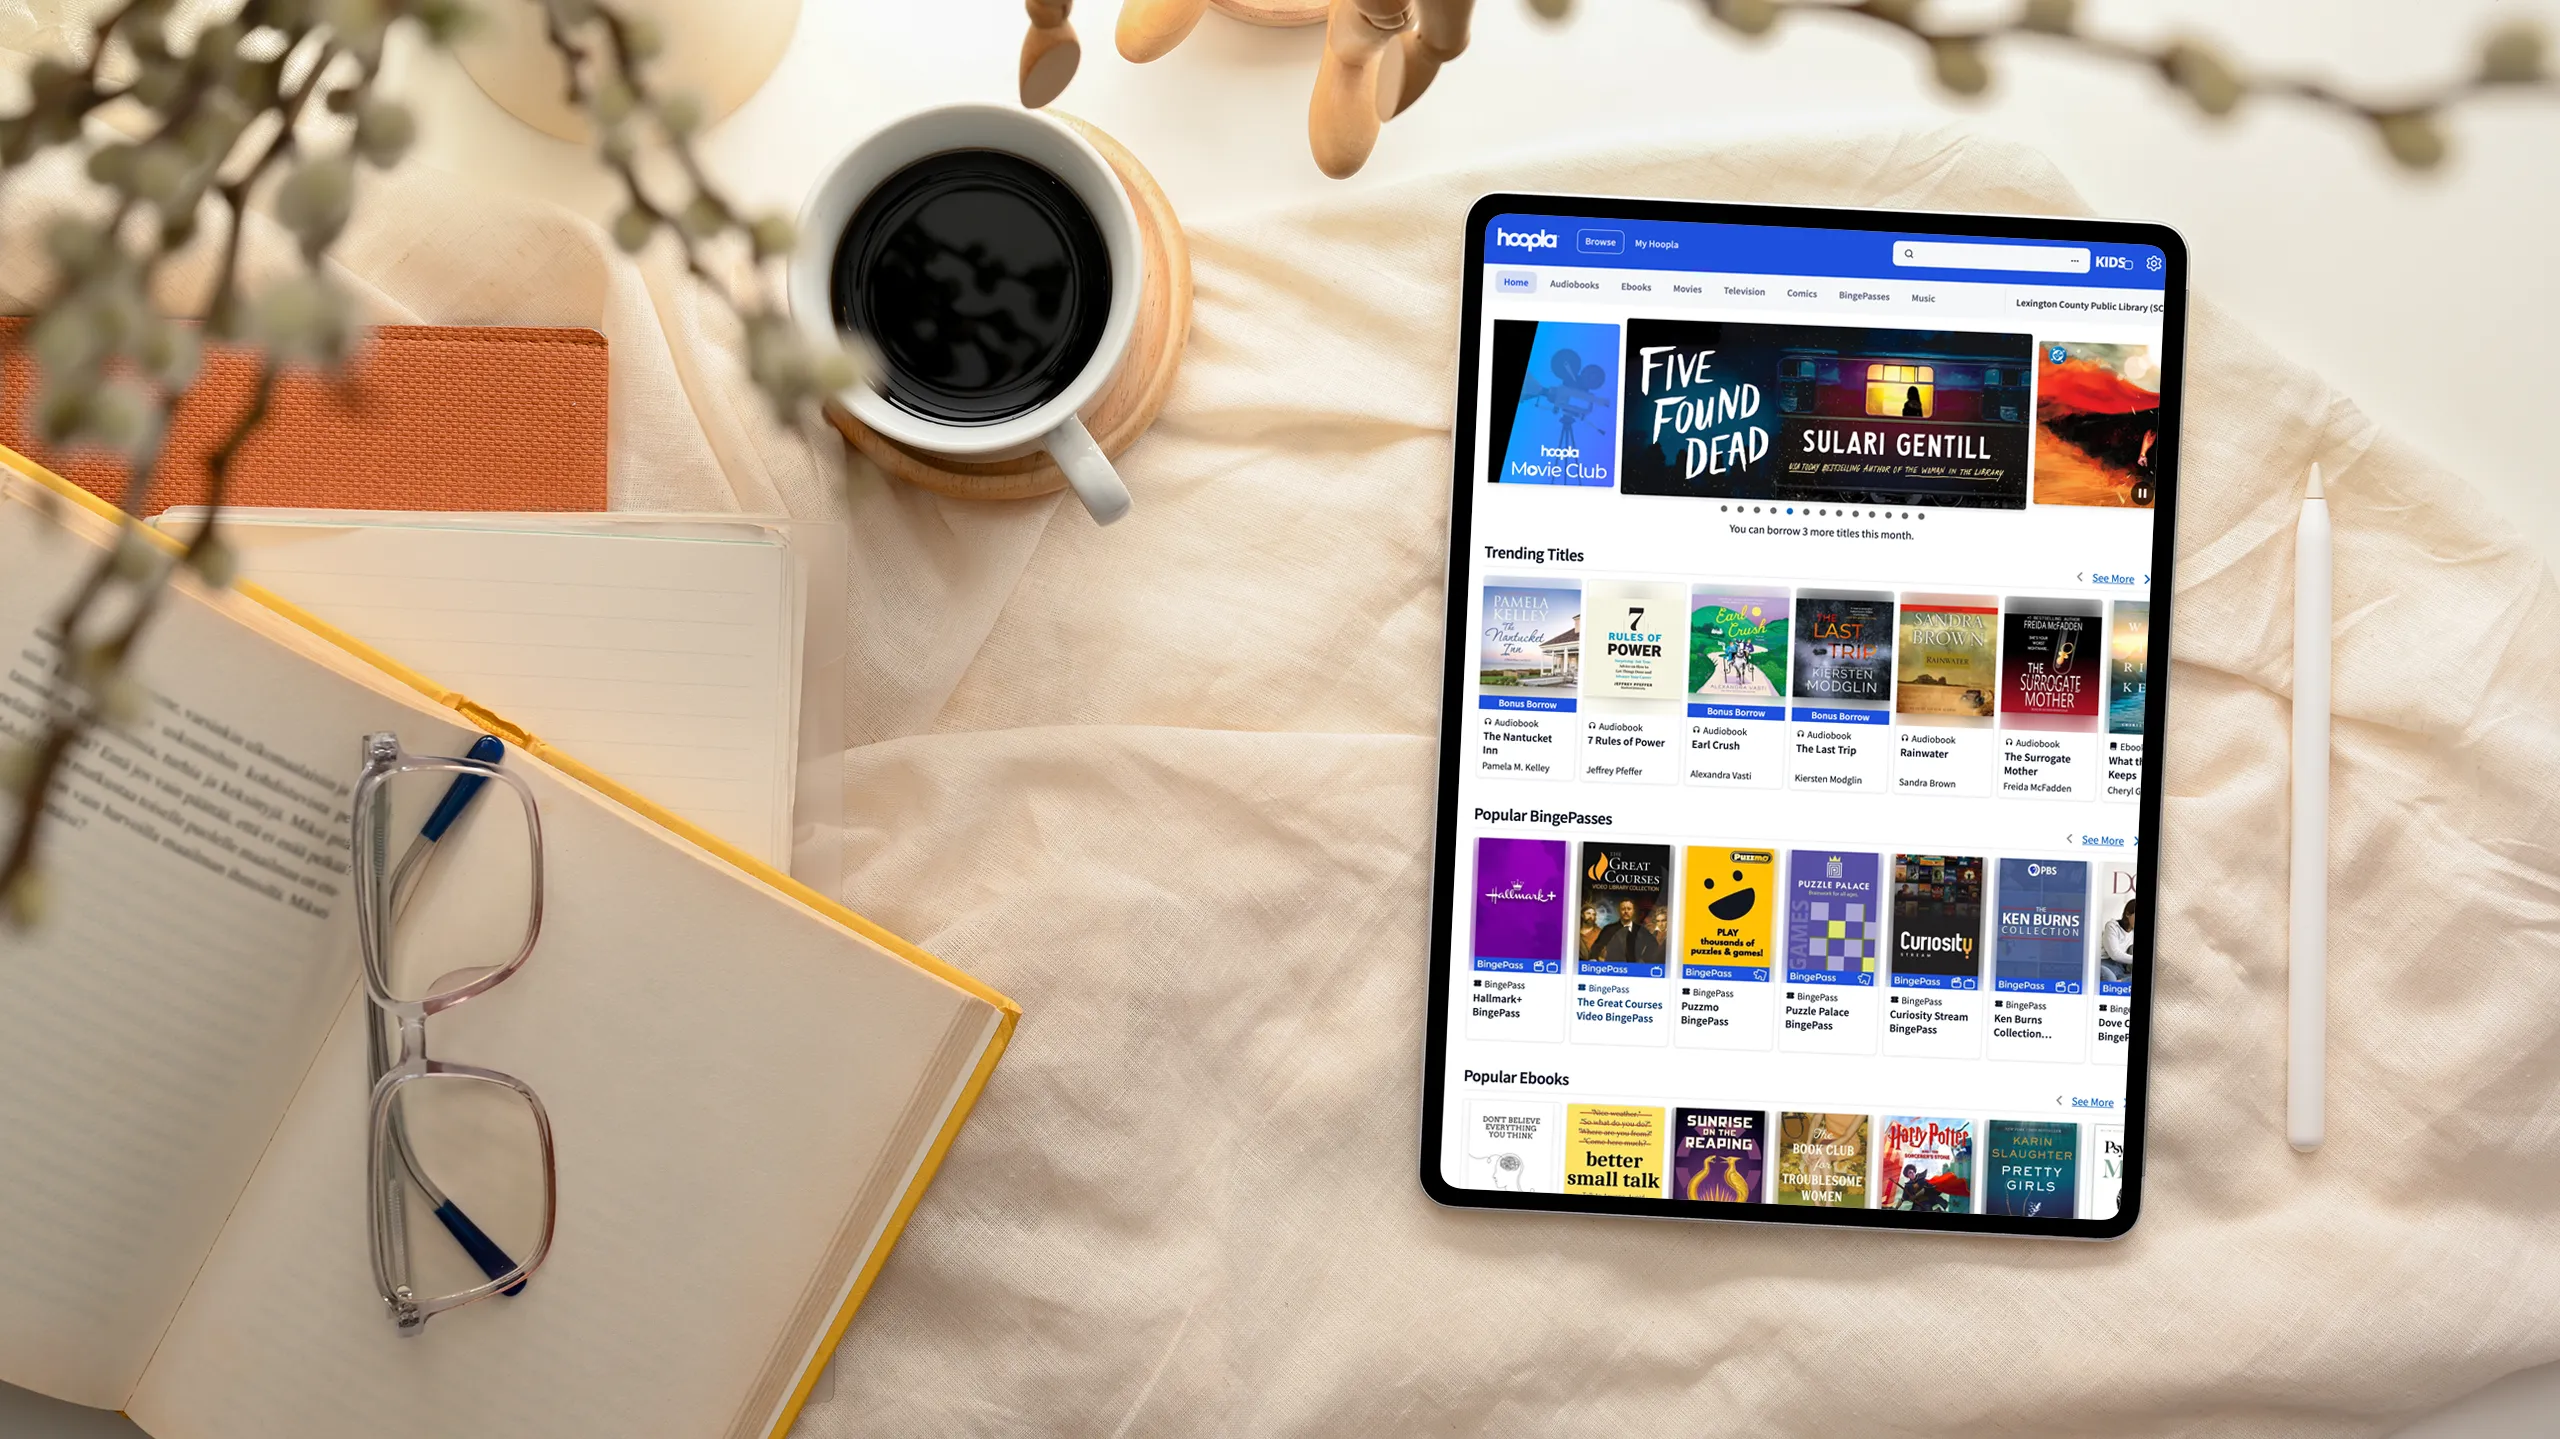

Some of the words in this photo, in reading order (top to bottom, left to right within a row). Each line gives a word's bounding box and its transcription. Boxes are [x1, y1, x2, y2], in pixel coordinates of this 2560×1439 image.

[1496, 226, 1558, 252] hoopla
[1585, 237, 1616, 247] Browse
[1635, 239, 1647, 250] My
[1649, 239, 1679, 250] Hoopla
[2095, 256, 2126, 268] KIDS
[1503, 277, 1529, 287] Home
[1549, 279, 1600, 290] Audiobooks
[1621, 282, 1652, 292] Ebooks
[1673, 284, 1703, 295] Movies
[1723, 286, 1766, 297] Television
[1787, 288, 1818, 299] Comics
[1839, 290, 1890, 302] BingePasses
[1911, 293, 1936, 303] Music
[2016, 298, 2057, 311] Lexington
[2059, 300, 2089, 312] County
[2090, 301, 2117, 312] Public
[2118, 302, 2148, 314] Library
[1639, 345, 1716, 396] FIVE
[1652, 383, 1760, 445] FOUND
[1802, 429, 1886, 457] SULARI
[1896, 432, 1991, 460] GENTILL
[1685, 426, 1769, 480] DEAD
[1511, 460, 1562, 478] Movie
[1565, 463, 1607, 480] Club
[1821, 463, 1861, 473] BESTSELLING
[1862, 463, 1890, 474] AUTHOR
[1921, 466, 1945, 475] WOMAN
[1729, 524, 1747, 535] You
[1748, 526, 1765, 535] can
[1766, 525, 1801, 537] borrow
[1802, 527, 1808, 537] 3
[1810, 529, 1834, 538] more
[1836, 528, 1860, 539] titles
[1861, 529, 1879, 540] this
[1881, 530, 1915, 541] month.
[1484, 545, 1545, 564] Trending
[1547, 547, 1585, 563] Titles
[2092, 573, 2108, 584] See
[2111, 573, 2135, 585] More
[1494, 595, 1549, 609] PAMELA
[1493, 608, 1549, 622] KELLEY
[1628, 607, 1645, 632] 7
[1715, 604, 1749, 624] Earl
[1913, 612, 1984, 629] SANDRA
[2023, 620, 2047, 630] FREIDA
[2047, 621, 2083, 631] McFADDEN
[1727, 617, 1768, 638] Crush
[1813, 622, 1864, 640] LAST
[1484, 627, 1545, 643] Nantucket
[1608, 632, 1644, 642] RULES
[1647, 632, 1662, 643] OF
[1912, 629, 1984, 647] BROWN
[1500, 643, 1523, 656] Inn
[1607, 642, 1662, 658] POWER
[1827, 642, 1877, 660] TRIP
[1926, 656, 1969, 665] RAINWATER
[1812, 668, 1873, 680] KIERSTEN
[1806, 679, 1877, 693] MODGLIN
[2020, 673, 2081, 693] SURROGATE
[1498, 698, 1524, 709] Bonus
[1526, 700, 1558, 710] Borrow
[2024, 691, 2075, 708] MOTHER
[1707, 706, 1733, 717] Bonus
[1494, 718, 1539, 729] Audiobook
[1598, 722, 1644, 733] Audiobook
[1502, 732, 1553, 744] Nantucket
[1595, 736, 1619, 748] Rules
[1631, 738, 1666, 748] Power
[1483, 745, 1499, 756] Inn
[1691, 740, 1710, 750] Earl
[1712, 740, 1740, 751] Crush
[1815, 745, 1835, 755] Last
[1836, 745, 1857, 758] Trip
[1900, 748, 1949, 760] Rainwater
[2024, 753, 2071, 766] Surrogate
[2108, 756, 2134, 766] What
[1586, 765, 1615, 778] Jeffrey
[1616, 766, 1643, 777] Pfeffer
[1690, 769, 1731, 780] Alexandra
[1731, 770, 1752, 781] Vasti
[2004, 766, 2038, 777] Mother
[2108, 770, 2137, 782] Keeps
[1794, 773, 1828, 784] Kiersten
[1829, 774, 1862, 786] Modglin
[1899, 778, 1928, 788] Sandra
[1929, 779, 1956, 789] Brown
[2003, 781, 2028, 792] Freida
[2030, 782, 2072, 793] McFadden
[1474, 807, 1528, 826] Popular
[1530, 809, 1613, 827] BingePasses
[2082, 834, 2098, 846] See
[1733, 852, 1770, 862] Puzzmo
[1609, 857, 1651, 872] GREAT
[2040, 865, 2058, 876] PBS
[1604, 870, 1660, 885] COURSES
[1629, 884, 1660, 892] COLLECTION
[1798, 879, 1833, 890] PUZZLE
[1835, 881, 1870, 891] PALACE
[2002, 912, 2030, 926] KEN
[2033, 913, 2080, 928] BURNS
[1717, 928, 1739, 938] PLAY
[1789, 899, 1810, 970] GAMES
[2001, 925, 2080, 937] COLLECTION
[1700, 937, 1742, 947] thousands
[1900, 930, 1973, 960] Curiosity
[1690, 947, 1722, 958] puzzles
[1733, 948, 1764, 958] games!
[1477, 959, 1524, 971] BingePass
[1685, 968, 1733, 979] BingePass
[1473, 993, 1523, 1005] Hallmark+
[1596, 997, 1622, 1009] Great
[1622, 999, 1663, 1010] Courses
[1681, 1001, 1719, 1013] Puzzmo
[1785, 1006, 1818, 1018] Puzzle
[1819, 1007, 1850, 1018] Palace
[1576, 1011, 1604, 1022] Video
[1890, 1009, 1932, 1023] Curiosity
[1933, 1011, 1969, 1022] Stream
[1994, 1014, 2012, 1025] Ken
[2013, 1014, 2043, 1025] Burns
[2098, 1018, 2123, 1028] Dove
[1994, 1028, 2052, 1040] Collection...
[1464, 1069, 1517, 1086] Popular
[1519, 1071, 1570, 1087] Ebooks
[1482, 1115, 1507, 1124] DON'T
[1508, 1116, 1541, 1126] BELIEVE
[1687, 1115, 1753, 1129] SUNRISE
[1485, 1123, 1537, 1133] EVERYTHING
[1703, 1127, 1717, 1137] ON
[1488, 1131, 1505, 1140] YOU
[1506, 1131, 1534, 1140] THINK
[1889, 1121, 1928, 1150] Harry
[1928, 1122, 1969, 1148] Potter
[2013, 1136, 2053, 1146] KARIN
[1685, 1136, 1753, 1151] REAPING
[1792, 1143, 1823, 1155] BOOK
[1825, 1144, 1855, 1157] CLUB
[1991, 1148, 2073, 1161] SLAUGHTER
[1586, 1150, 1644, 1168] better
[1812, 1155, 1834, 1170] for
[2001, 1165, 2063, 1178] PRETTY
[1567, 1170, 1618, 1188] small
[1623, 1172, 1660, 1189] talk
[1781, 1173, 1863, 1188] TROUBLESOME
[2006, 1180, 2056, 1192] GIRLS
[1801, 1189, 1843, 1203] WOMEN
